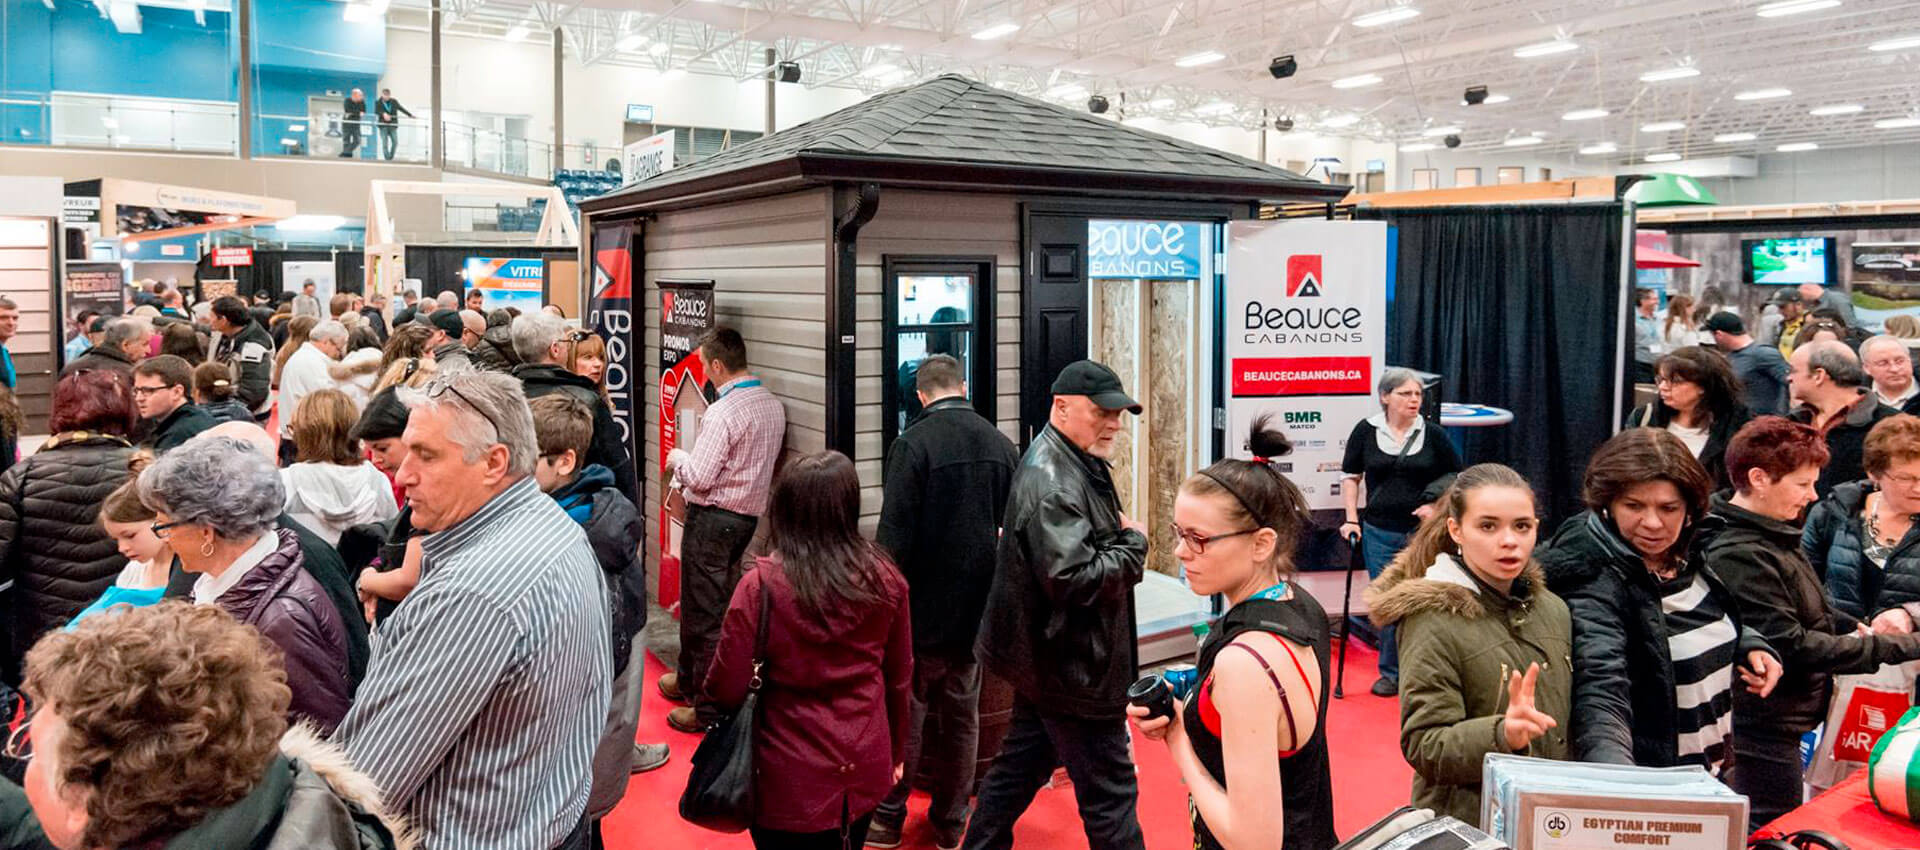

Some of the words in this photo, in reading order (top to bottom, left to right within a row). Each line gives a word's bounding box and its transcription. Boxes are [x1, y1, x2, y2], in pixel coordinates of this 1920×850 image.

[674, 293, 707, 318] Beauce
[1245, 301, 1361, 330] Beauce
[663, 333, 690, 351] PROMOS
[1244, 332, 1363, 344] CABANONS
[663, 350, 677, 363] EXPO
[1243, 370, 1362, 383] BEAUCECABANONS.CA
[1284, 411, 1322, 423] BMR
[1583, 817, 1643, 831] EGYPTIAN
[1647, 821, 1703, 834] PREMIUM
[1614, 832, 1671, 846] COMFORT
